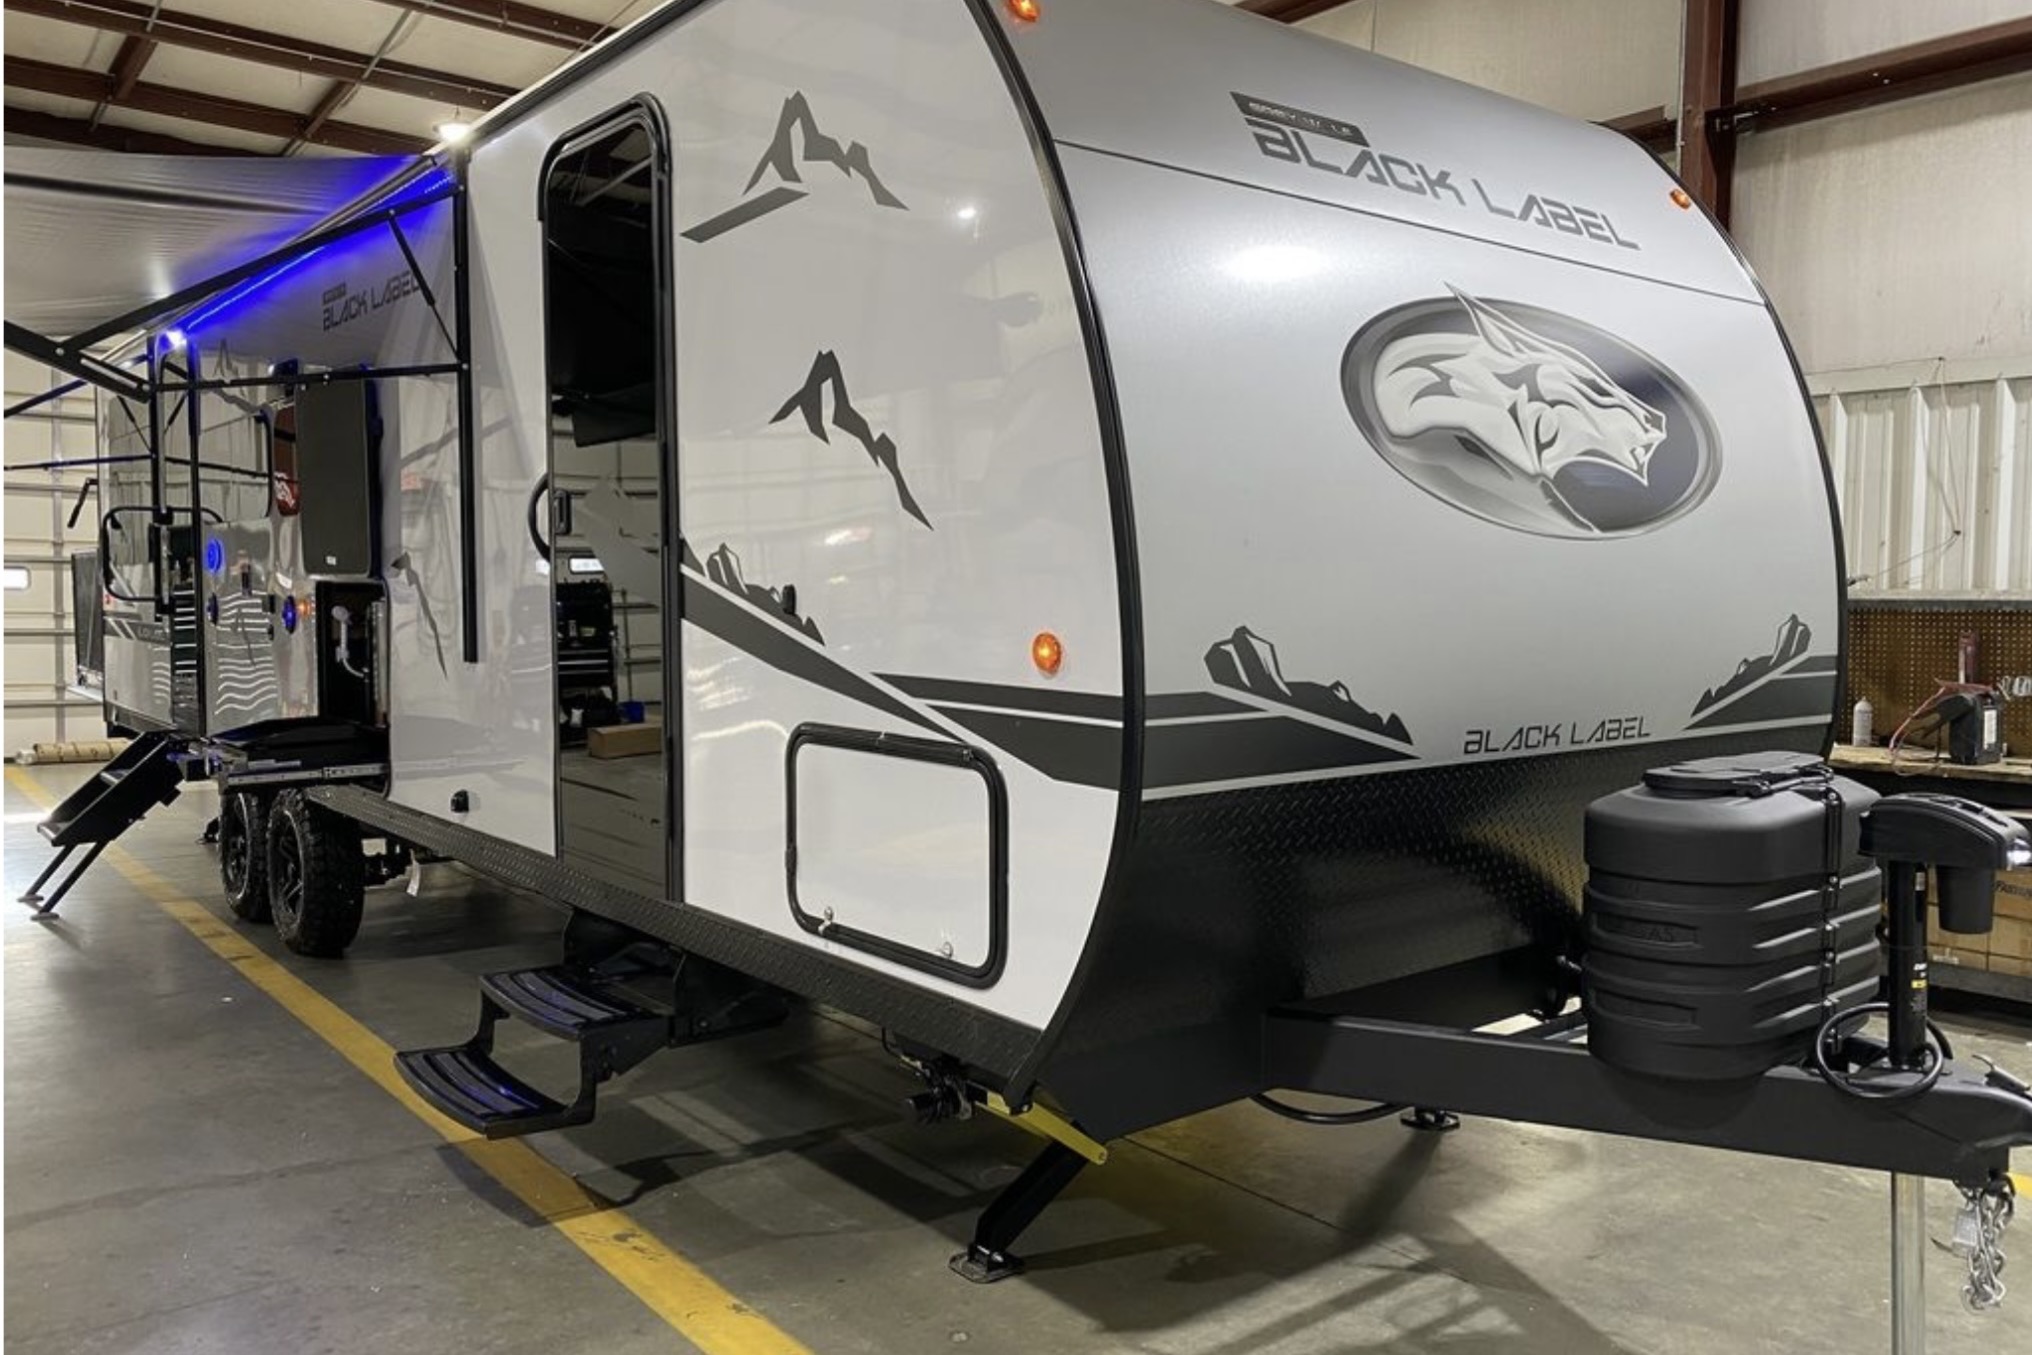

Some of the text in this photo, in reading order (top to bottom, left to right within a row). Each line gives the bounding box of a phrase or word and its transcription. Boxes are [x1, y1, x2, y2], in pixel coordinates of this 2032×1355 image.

[1244, 117, 1466, 206] BLACK
[1471, 178, 1641, 250] LABEL
[323, 289, 367, 331] BLACK
[1464, 716, 1651, 755] BLACK LABEL
